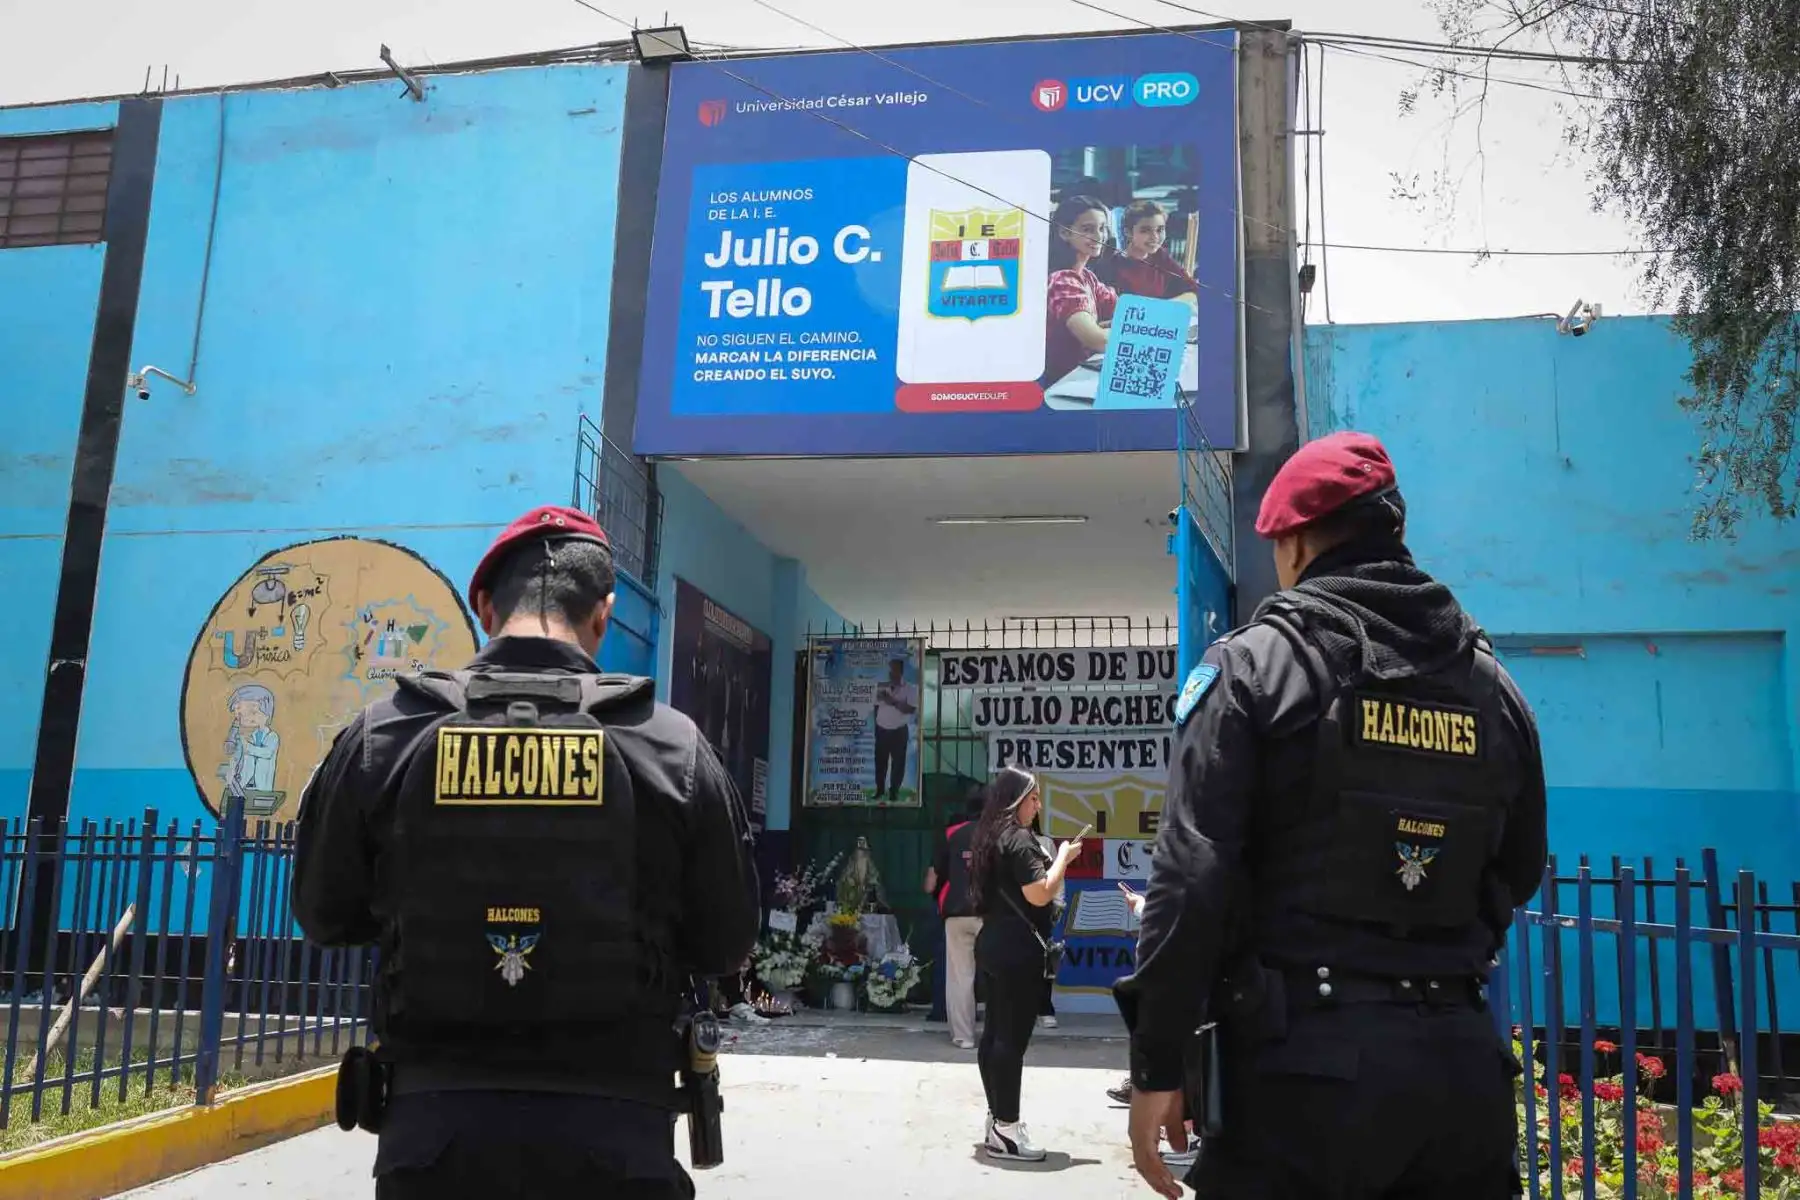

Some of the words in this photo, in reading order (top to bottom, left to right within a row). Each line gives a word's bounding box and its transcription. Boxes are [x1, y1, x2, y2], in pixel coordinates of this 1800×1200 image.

[1077, 84, 1124, 103] UCV
[1143, 81, 1190, 99] PRO
[736, 97, 824, 113] Universidad
[827, 95, 872, 108] César
[875, 91, 928, 106] Vallejo
[710, 192, 738, 204] LOS
[741, 189, 814, 202] ALUMNOS
[708, 209, 727, 220] DE
[731, 208, 749, 219] LA
[765, 207, 776, 218] E.
[959, 225, 965, 237] I
[981, 224, 995, 236] E
[704, 226, 819, 268] Julio
[833, 224, 882, 264] C.
[701, 278, 812, 318] Tello
[941, 294, 1009, 306] VITARTE
[1124, 306, 1146, 321] ¡Tú
[696, 334, 718, 347] NO
[722, 332, 775, 346] SIGUEN
[779, 332, 795, 344] EL
[799, 331, 862, 344] CAMINO.
[1120, 322, 1179, 341] puedes!
[695, 351, 760, 364] MARCAN
[764, 350, 783, 362] LA
[787, 348, 877, 362] DIFERENCIA
[693, 369, 766, 382] CREANDO
[770, 369, 787, 380] EL
[791, 367, 836, 380] SUYO.
[941, 652, 1075, 686] ESTAMOS
[1088, 651, 1127, 681] DE
[1137, 650, 1176, 680] DU
[975, 695, 1062, 726] JULIO
[1069, 694, 1177, 726] PACHEC
[1362, 699, 1477, 756] HALCONES
[440, 735, 598, 796] HALCONES
[1097, 811, 1106, 833] I
[1139, 811, 1161, 833] E
[1398, 819, 1445, 837] HALCONES
[487, 907, 540, 923] HALCONES
[1064, 947, 1133, 968] VITA
